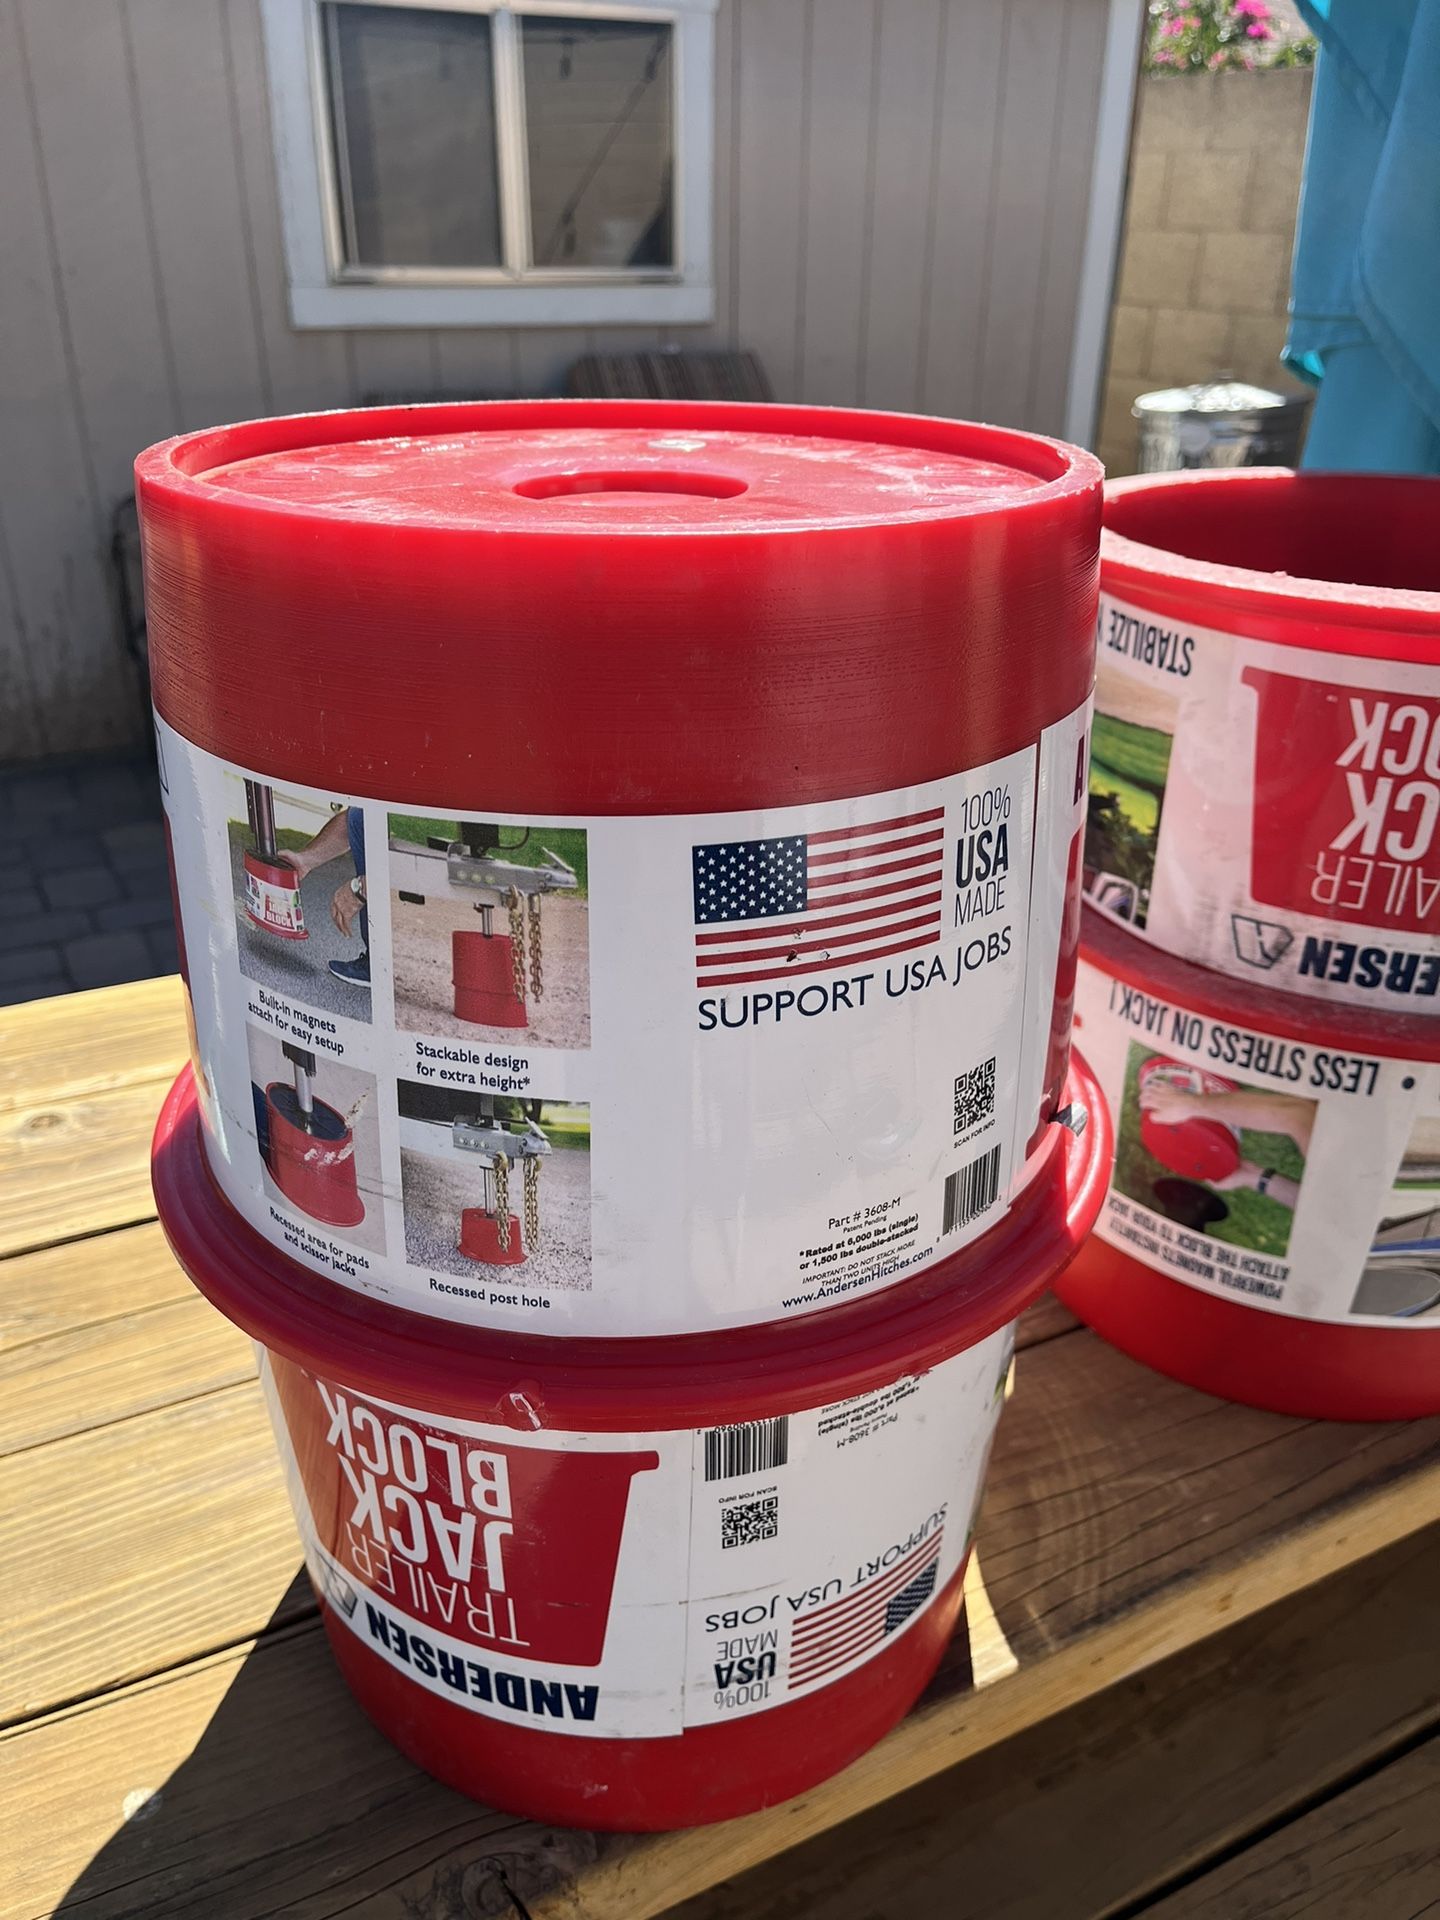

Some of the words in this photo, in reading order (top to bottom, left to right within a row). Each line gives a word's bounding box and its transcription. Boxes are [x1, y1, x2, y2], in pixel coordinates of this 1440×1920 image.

[1107, 609, 1194, 677] STABILIZE
[961, 784, 1011, 833] 100%
[956, 823, 1008, 888] USA
[954, 877, 1006, 927] MADE
[699, 974, 874, 1030] SUPPORT
[886, 955, 946, 997] USA
[953, 926, 1012, 985] JOBS
[248, 1001, 273, 1023] attach
[275, 1015, 288, 1031] for
[291, 1025, 312, 1044] easy
[315, 1034, 344, 1056] setup
[259, 989, 290, 1016] Built-in
[293, 1009, 336, 1033] magnets
[1171, 1011, 1203, 1050] ON
[416, 1041, 480, 1064] Stackable
[484, 1053, 529, 1072] design
[1208, 1025, 1305, 1081] STRESS
[416, 1061, 436, 1077] for
[440, 1069, 476, 1085] extra
[1310, 1052, 1380, 1095] LESS
[828, 1216, 850, 1229] Part
[853, 1212, 861, 1221] #
[864, 1197, 901, 1218] 3608-M
[836, 1241, 845, 1250] at
[848, 1232, 871, 1246] 6,000
[874, 1227, 886, 1237] lbs
[889, 1213, 919, 1232] (single)
[843, 1223, 863, 1234] Patent
[864, 1215, 887, 1227] Pending
[270, 1206, 305, 1239] Recessed
[307, 1233, 327, 1251] area
[329, 1242, 343, 1258] for
[346, 1253, 369, 1269] pads
[284, 1231, 298, 1247] and
[300, 1242, 329, 1263] scissor
[332, 1256, 356, 1276] jacks
[800, 1262, 809, 1270] or
[812, 1254, 837, 1268] 1,500
[840, 1249, 853, 1259] lbs
[856, 1223, 919, 1254] double-stacked
[1216, 1247, 1237, 1267] THE
[782, 1246, 933, 1308] www.AndersenHitches.com
[802, 1267, 846, 1284] IMPORTANT:
[847, 1262, 858, 1271] DO
[860, 1255, 875, 1267] NOT
[876, 1249, 895, 1261] STACK
[896, 1240, 915, 1251] MORE
[822, 1275, 841, 1287] THAN
[843, 1269, 860, 1281] TWO
[861, 1261, 880, 1275] UNITS
[881, 1254, 899, 1267] HIGH
[1161, 1245, 1214, 1279] MAGNETS
[1240, 1256, 1291, 1280] ATTACH
[429, 1278, 485, 1300] Recessed
[490, 1292, 518, 1305] post
[522, 1294, 551, 1308] hole
[1219, 1268, 1284, 1300] POWERFUL
[836, 1427, 870, 1448] 3608-M
[881, 1413, 898, 1426] Part
[315, 1379, 513, 1519] BLOCK
[718, 1496, 737, 1504] INFO
[739, 1492, 754, 1500] FOR
[757, 1486, 777, 1495] SCAN
[337, 1451, 514, 1592] JACK
[850, 1502, 948, 1587] SUPPORT
[346, 1522, 530, 1646] TRAILER
[787, 1578, 842, 1611] USA
[706, 1595, 780, 1632] JOBS
[365, 1601, 599, 1721] ANDERSEN
[717, 1629, 778, 1661] MADE
[714, 1651, 776, 1690] USA
[713, 1681, 772, 1710] 100%
